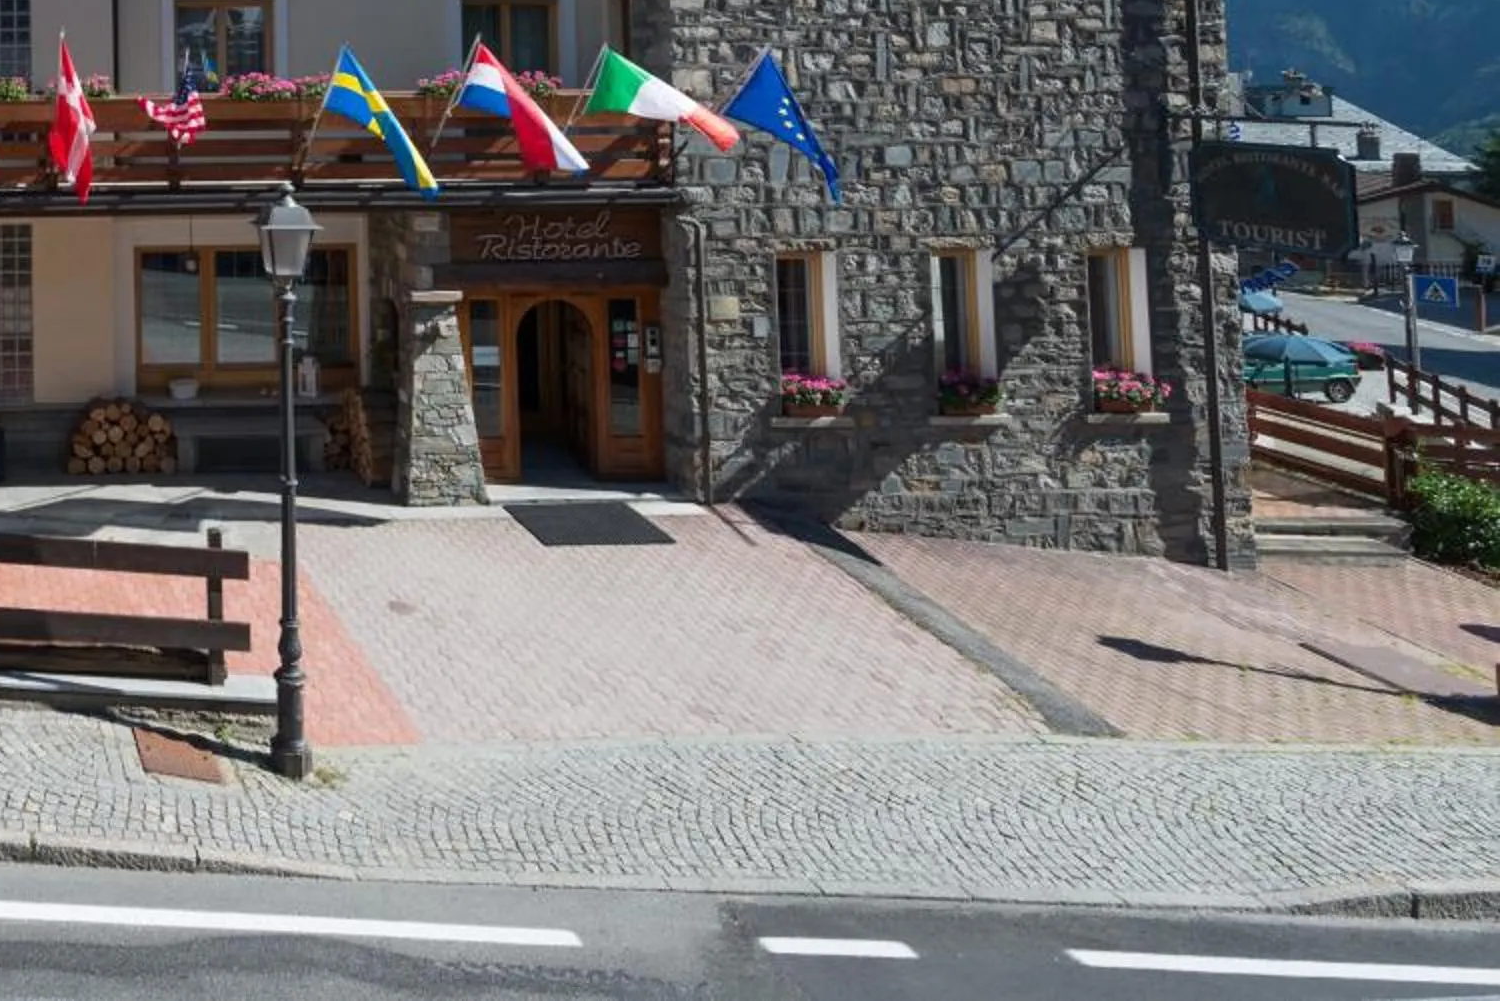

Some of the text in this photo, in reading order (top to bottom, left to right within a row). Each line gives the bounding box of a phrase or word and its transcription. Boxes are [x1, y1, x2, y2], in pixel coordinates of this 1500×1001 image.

[504, 210, 611, 240] Hotel
[1217, 218, 1327, 249] TOURIST
[475, 233, 642, 263] Ristorante
